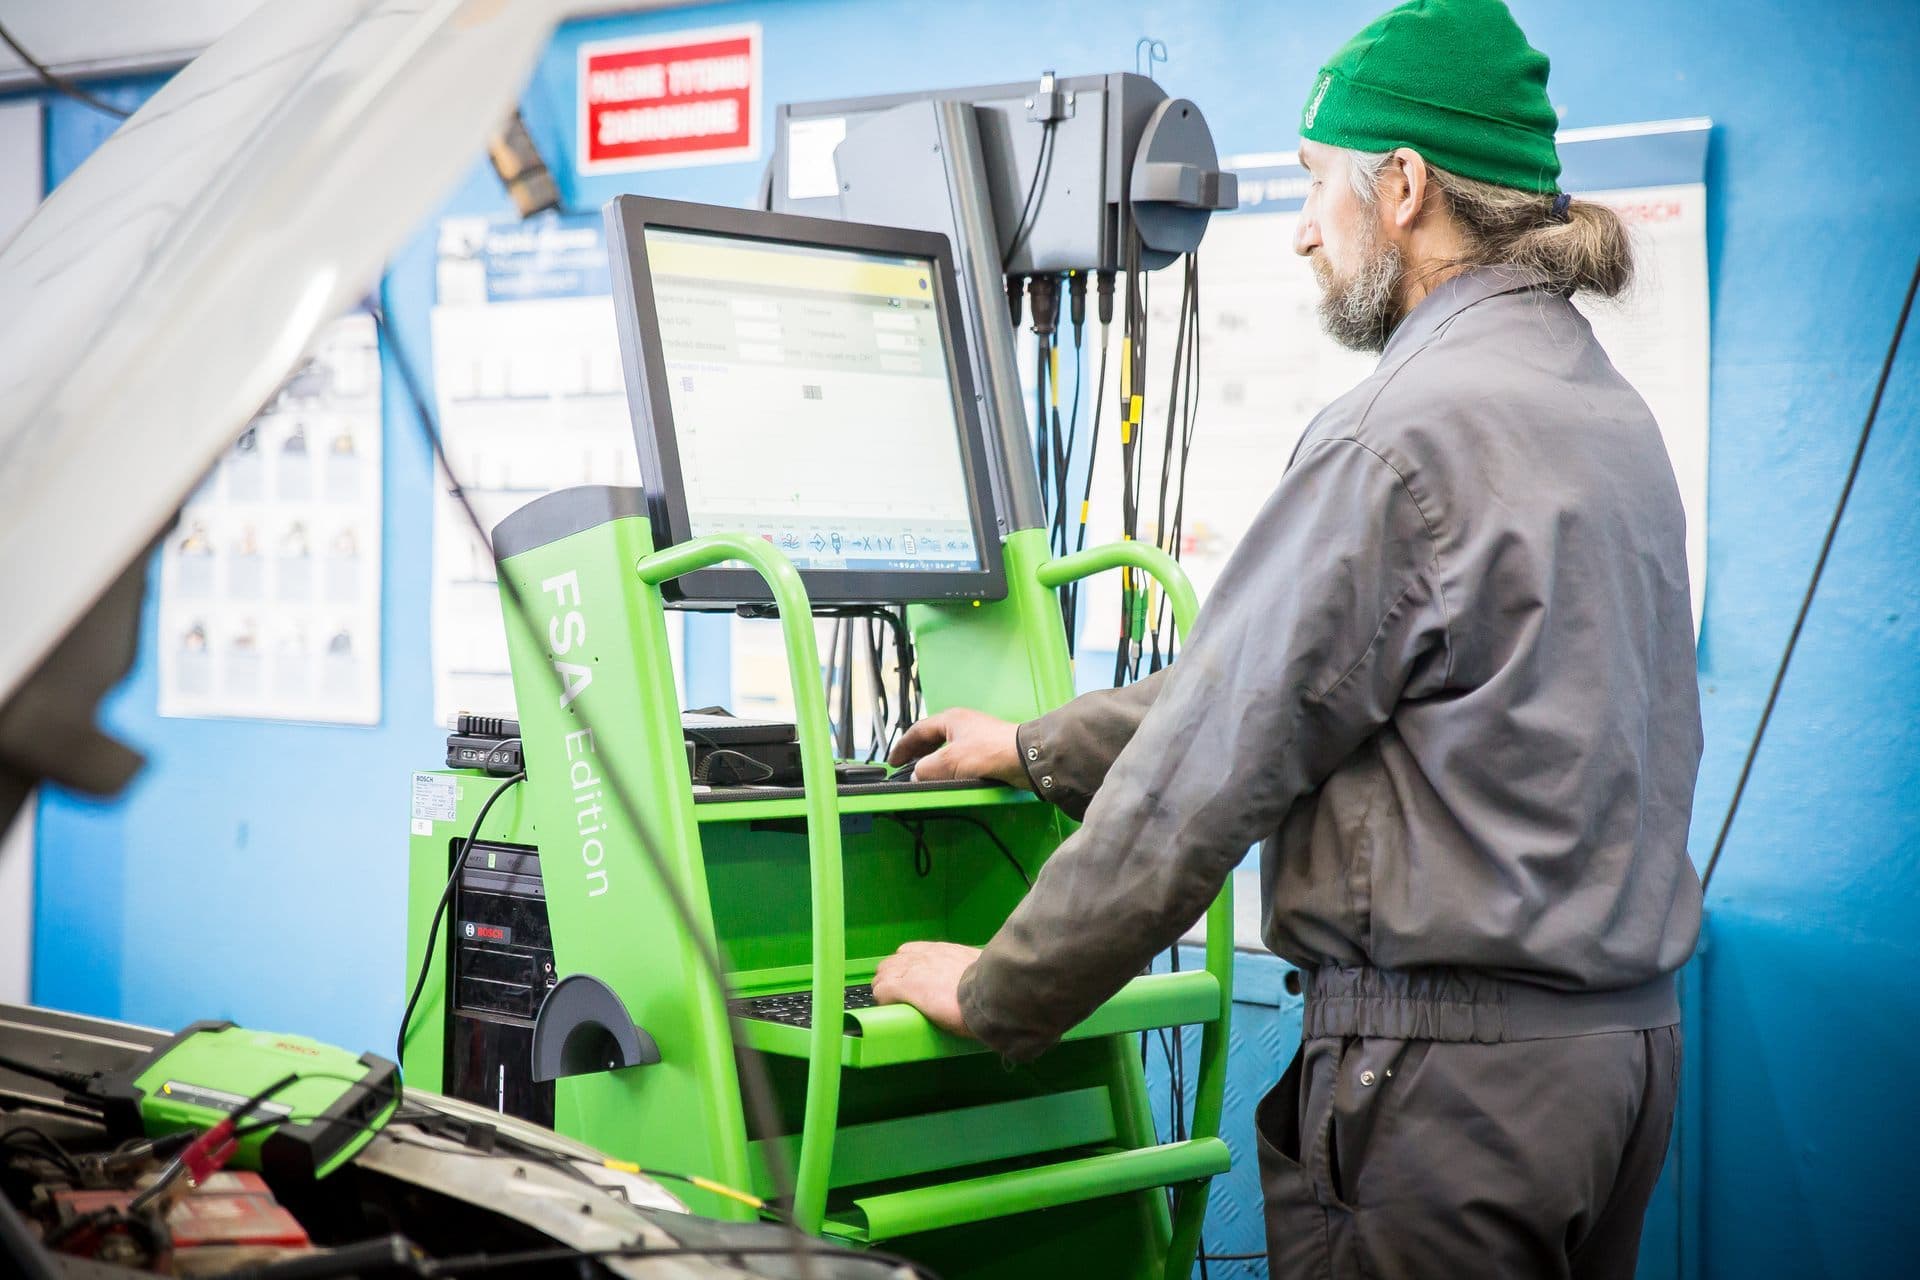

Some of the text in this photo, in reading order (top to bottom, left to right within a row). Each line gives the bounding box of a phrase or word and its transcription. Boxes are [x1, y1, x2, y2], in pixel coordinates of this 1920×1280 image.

[542, 569, 609, 897] FSA Edition
[477, 927, 503, 938] BOSCH
